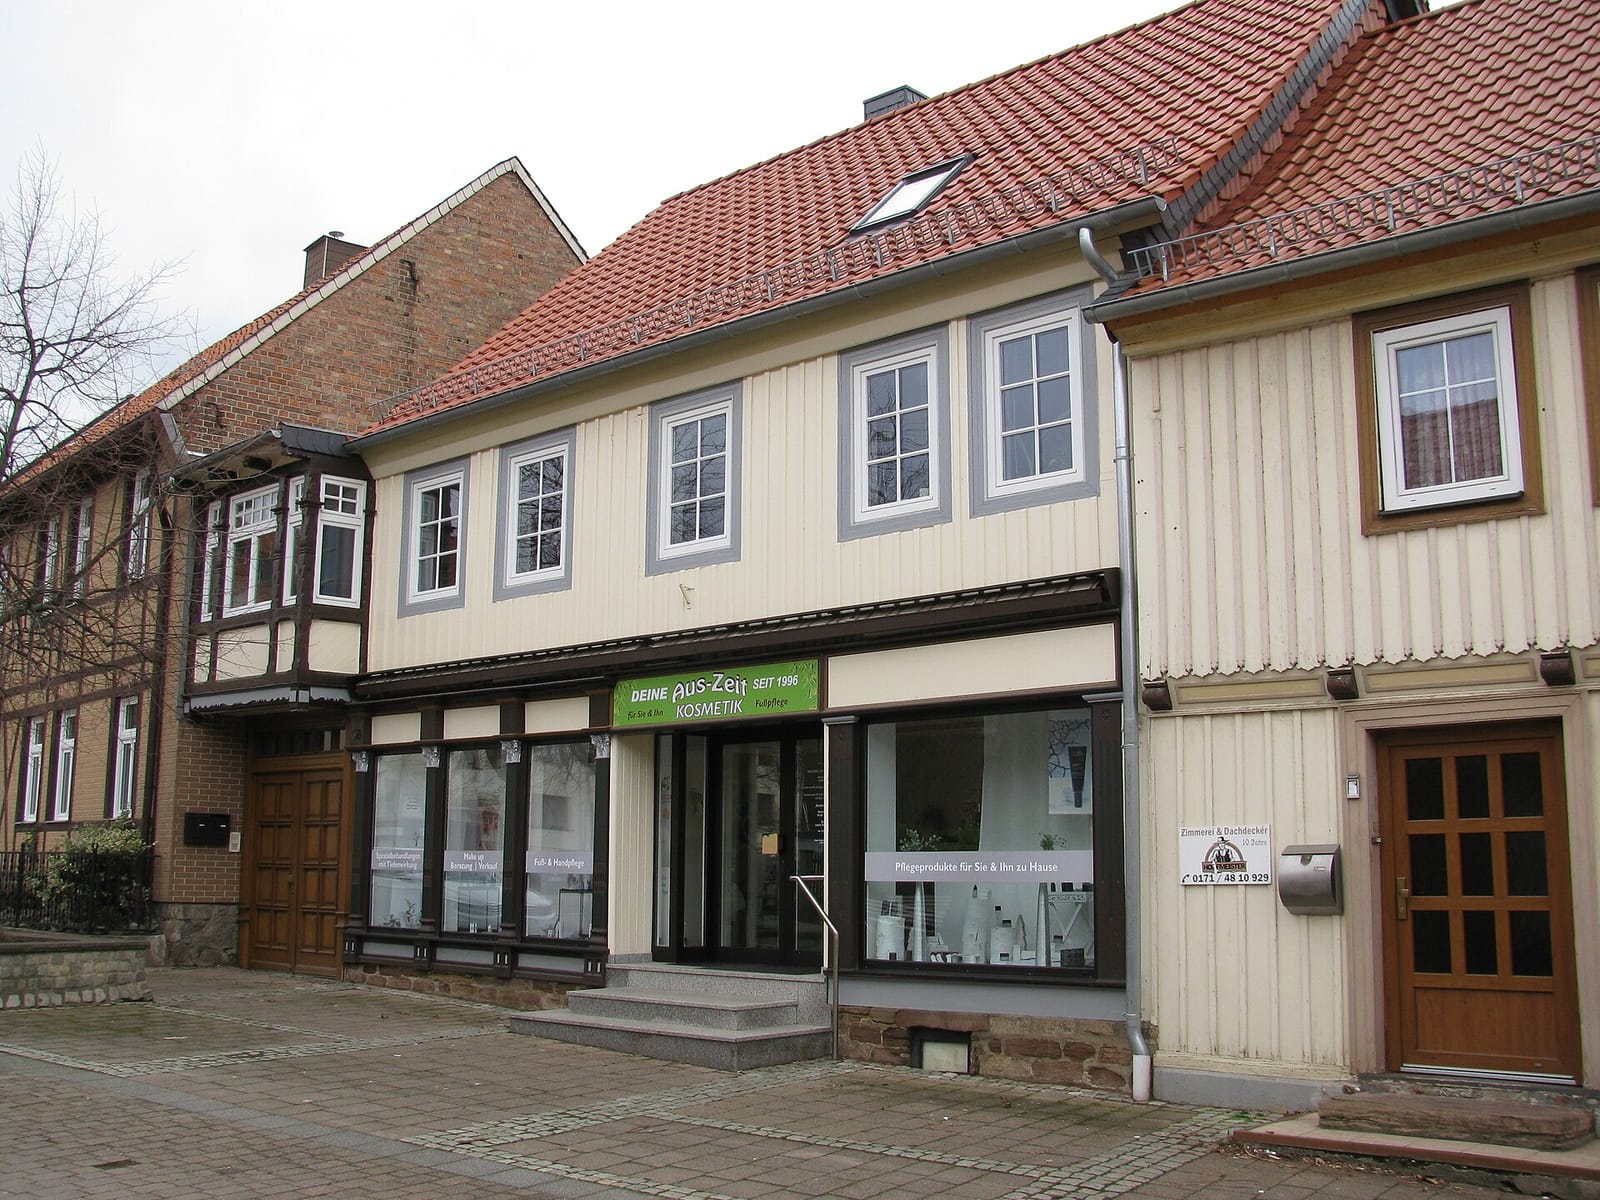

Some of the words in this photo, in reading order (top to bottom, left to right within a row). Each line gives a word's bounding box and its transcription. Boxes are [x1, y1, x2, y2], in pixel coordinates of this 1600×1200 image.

[631, 687, 668, 703] DEINE
[672, 673, 748, 703] Aus-Zeit
[752, 677, 775, 690] SEIT
[777, 675, 799, 688] 1996
[755, 698, 788, 709] Fußpflege
[637, 710, 646, 718] Sie
[647, 709, 653, 718] &
[654, 708, 664, 717] Ihn
[676, 699, 743, 719] KOSMETIK
[1181, 828, 1215, 837] Zimmerei
[1216, 827, 1223, 836] &
[463, 852, 477, 860] Make
[450, 861, 473, 871] Beratung
[478, 861, 499, 870] Verkauf
[547, 858, 553, 866] &
[553, 858, 585, 869] Handpflege
[895, 861, 958, 874] Pflegeprodukte
[960, 861, 973, 872] für
[974, 861, 988, 872] Sie
[990, 861, 998, 872] &
[999, 861, 1014, 872] Ihn
[1016, 864, 1027, 872] zu
[1029, 861, 1058, 872] Hause
[1192, 874, 1215, 882] 0171
[1224, 874, 1236, 882] 48
[1238, 874, 1250, 882] 10
[1251, 873, 1269, 882] 929
